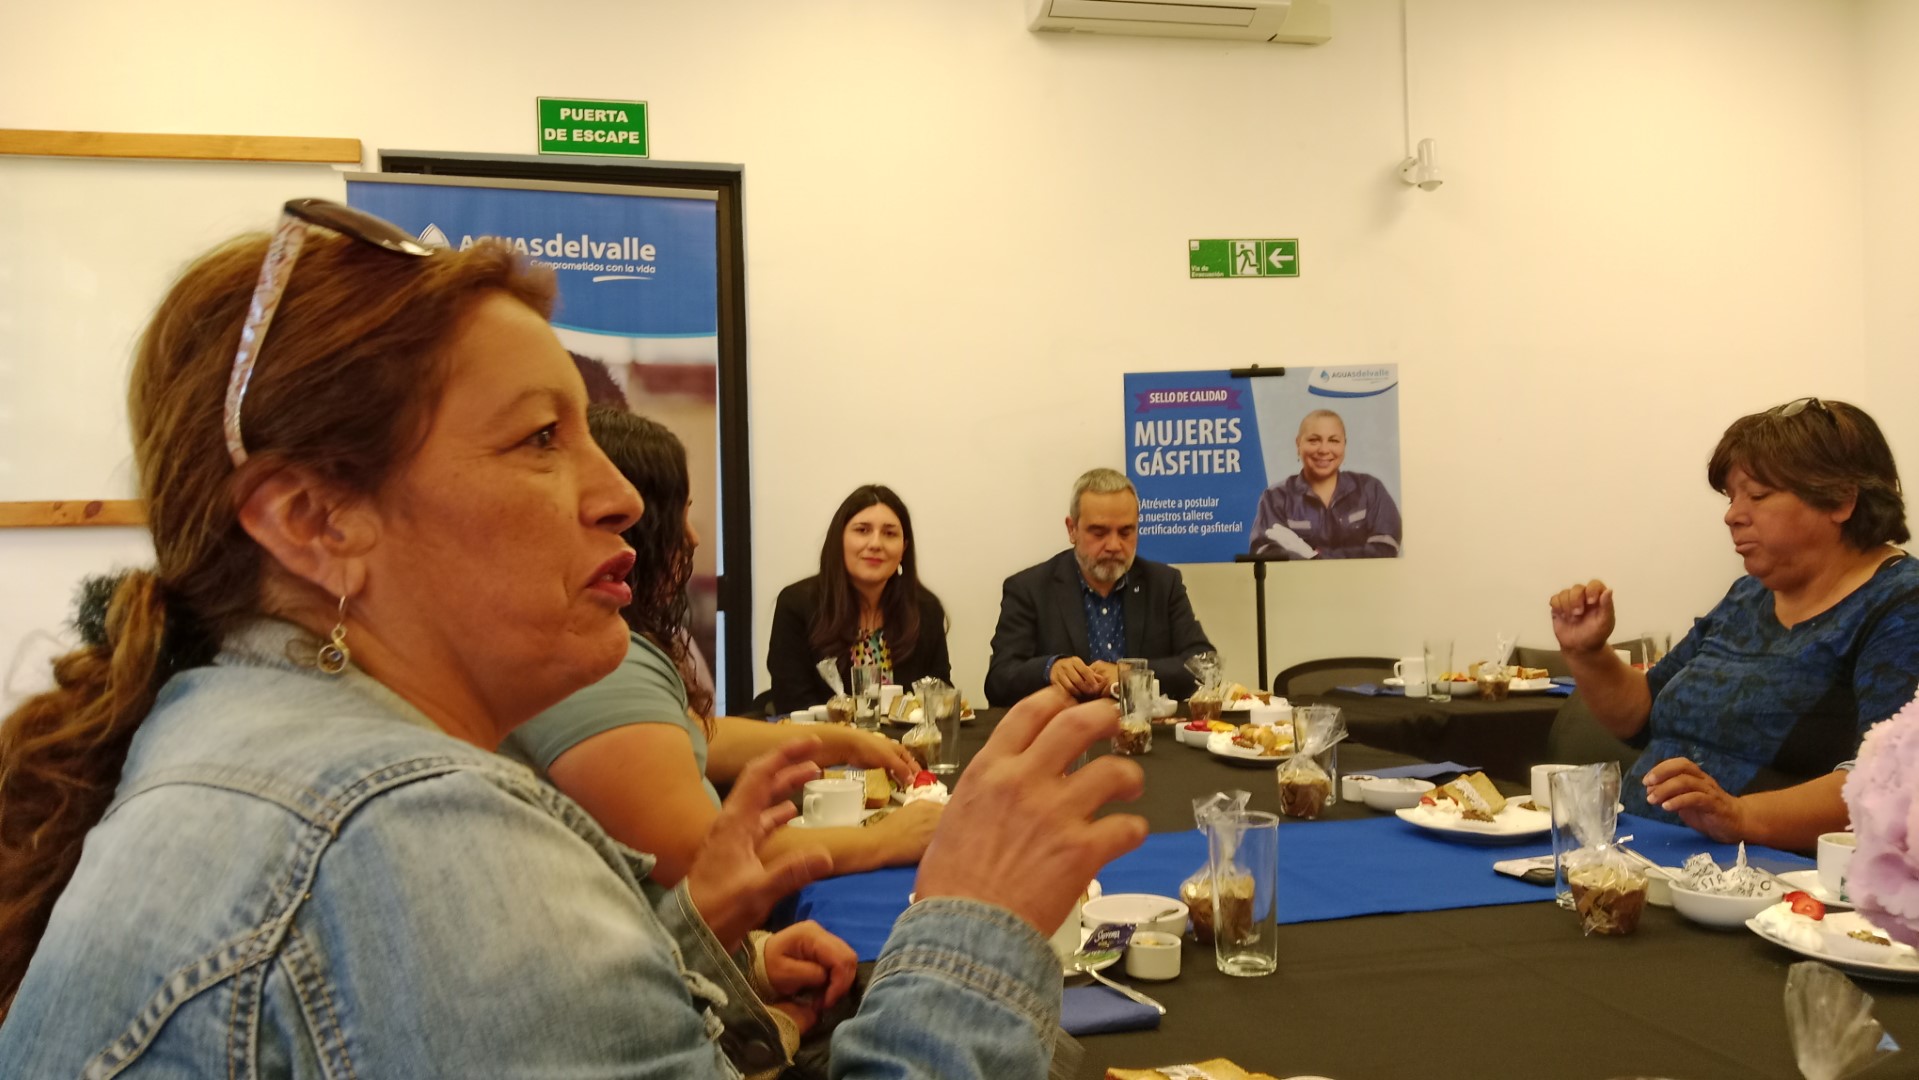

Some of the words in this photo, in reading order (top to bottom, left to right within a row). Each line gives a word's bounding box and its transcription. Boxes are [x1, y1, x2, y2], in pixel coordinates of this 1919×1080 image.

[560, 107, 629, 123] PUERTA
[544, 128, 568, 141] DE
[572, 129, 640, 144] ESCAPE
[606, 263, 624, 272] con
[625, 264, 634, 273] la
[636, 264, 656, 273] vida
[1149, 391, 1176, 404] SELLO
[1177, 391, 1189, 403] DE
[1189, 389, 1228, 402] CALIDAD
[1134, 417, 1242, 447] MUJERES
[1134, 446, 1241, 476] GÁSFITER
[1177, 499, 1183, 508] a
[1184, 496, 1220, 510] postular
[1138, 513, 1144, 522] a
[1145, 511, 1181, 522] nuestros
[1182, 509, 1214, 521] talleres
[1138, 523, 1187, 535] certificados
[1188, 523, 1199, 533] de
[1200, 521, 1243, 536] gasfitería!
